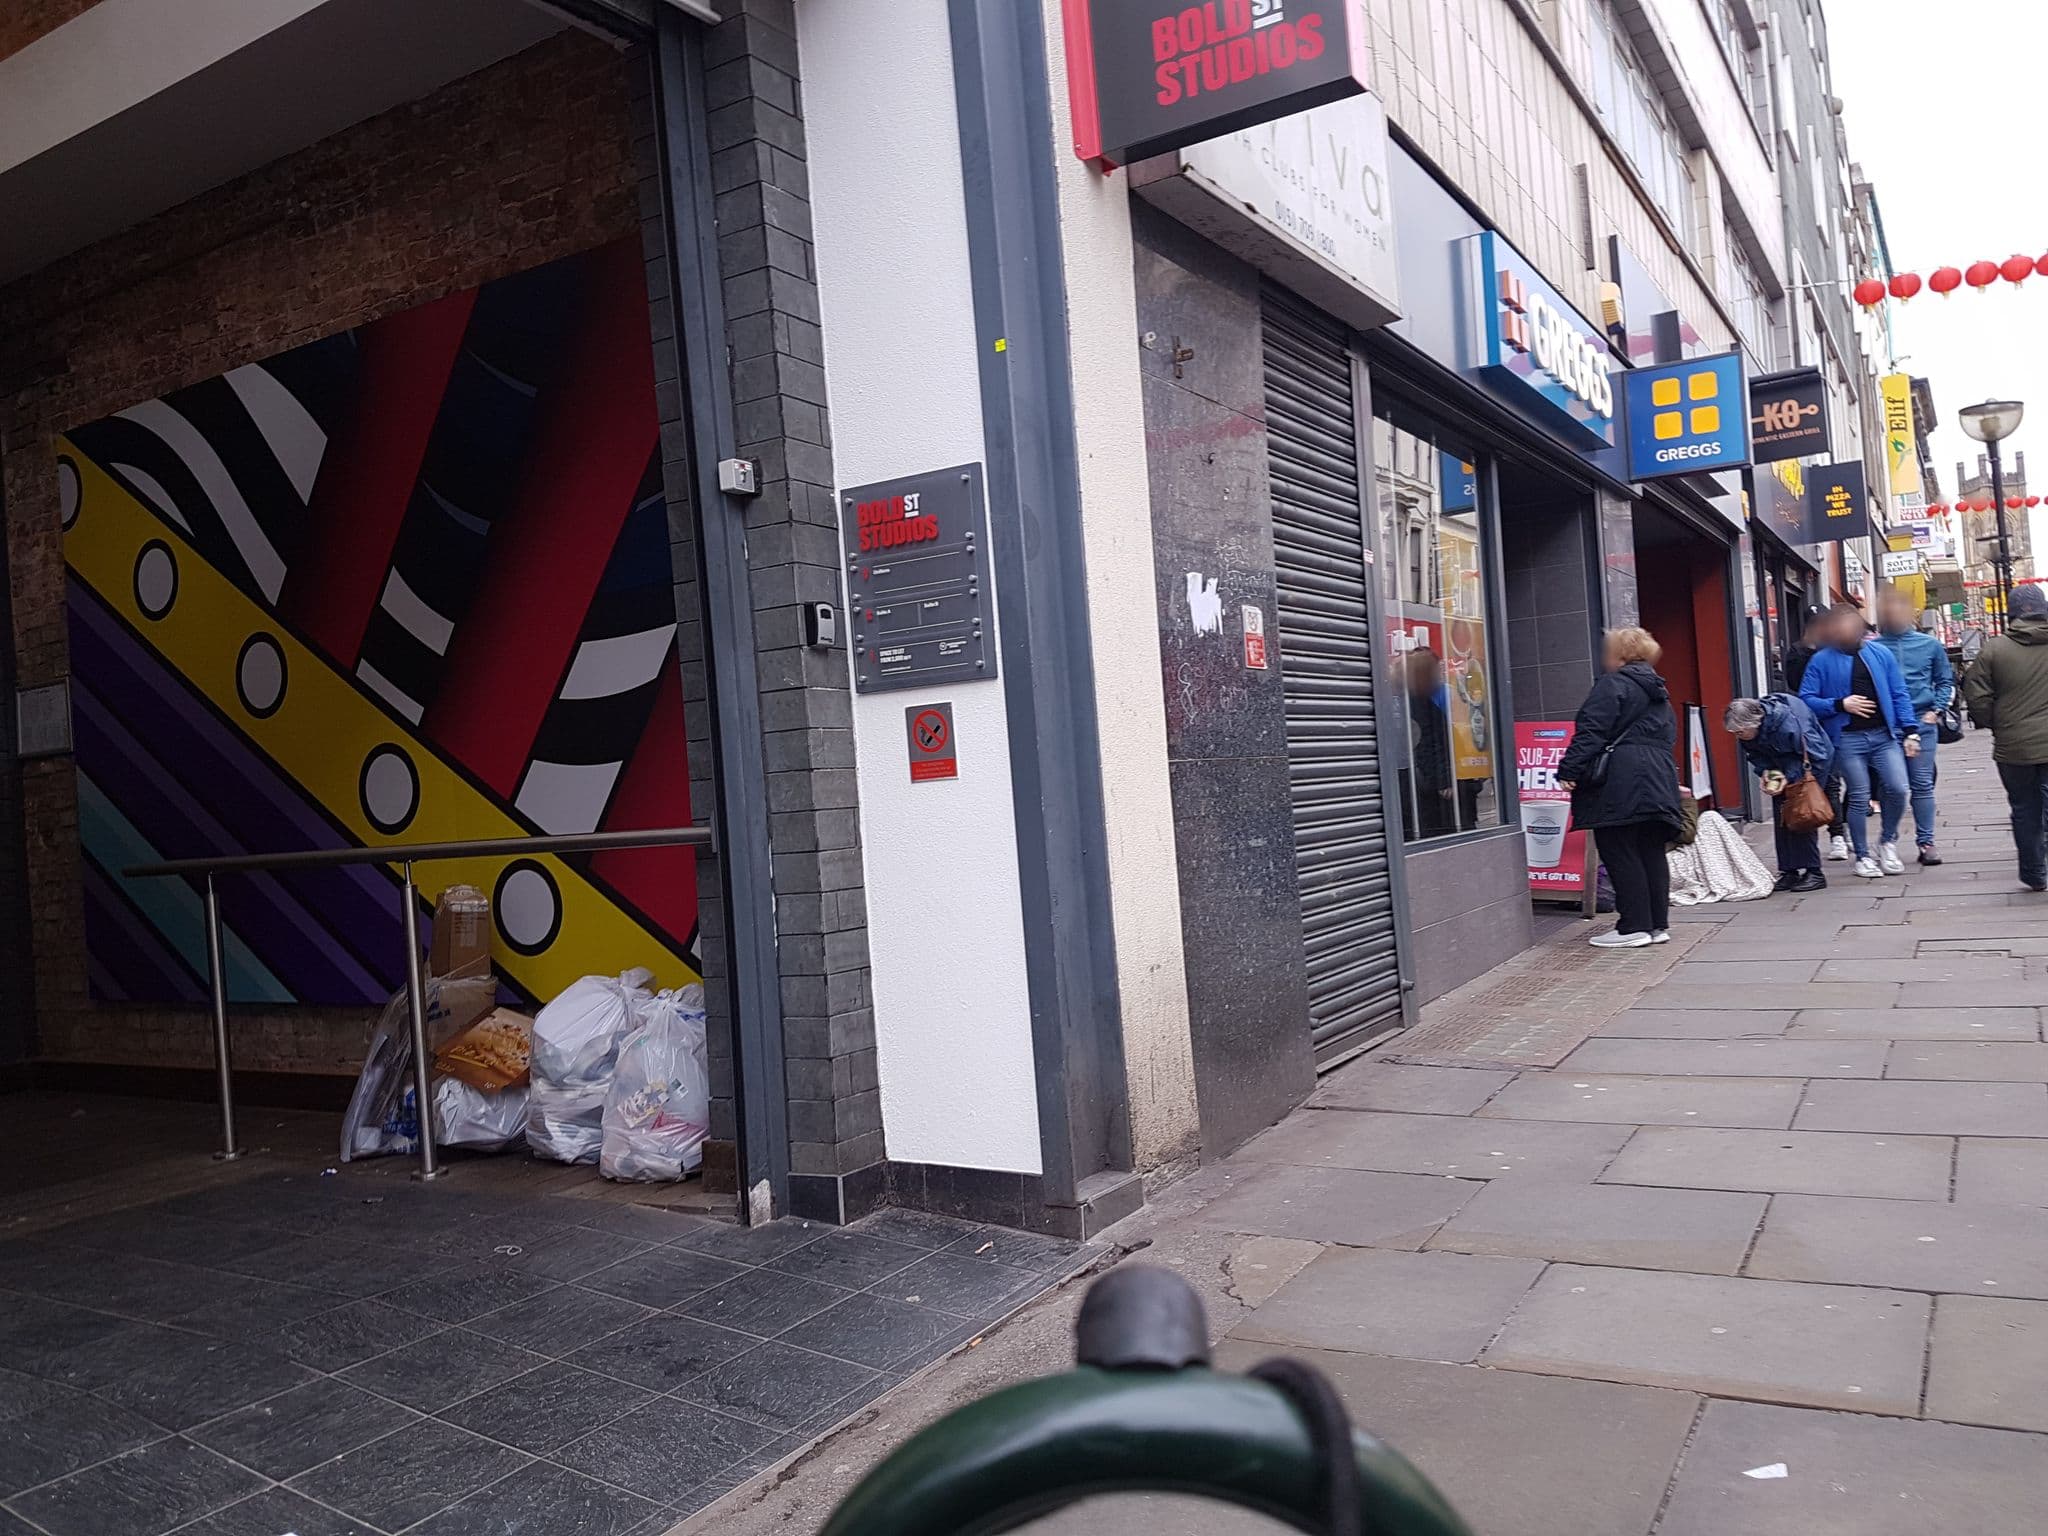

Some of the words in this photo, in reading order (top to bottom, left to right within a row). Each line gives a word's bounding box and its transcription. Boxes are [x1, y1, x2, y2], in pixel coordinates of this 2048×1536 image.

[1152, 0, 1250, 62] BOLD
[1155, 13, 1326, 106] STUDIOS
[1528, 293, 1613, 419] GREGGS
[1887, 396, 1908, 433] Elif
[1655, 441, 1722, 462] GREGGS
[1825, 492, 1852, 502] PIZZA
[1831, 485, 1843, 493] IN
[857, 496, 904, 527] BOLD
[904, 493, 920, 511] ST
[1826, 507, 1853, 517] TRUST
[1831, 500, 1846, 509] WE
[859, 513, 939, 552] STUDIOS
[1516, 766, 1562, 791] HER
